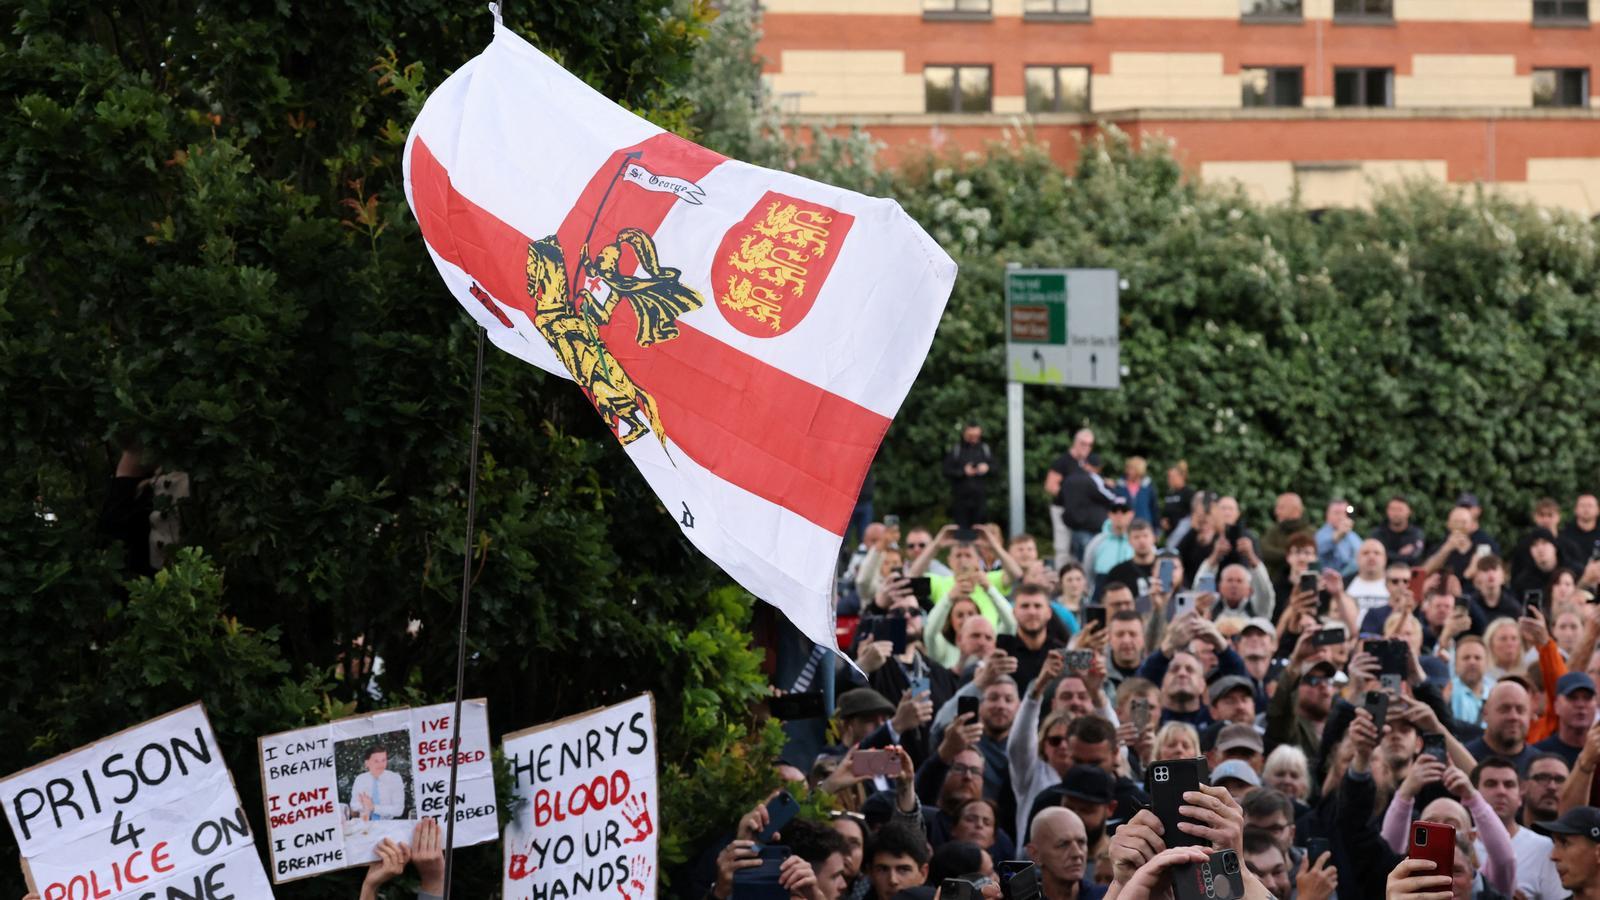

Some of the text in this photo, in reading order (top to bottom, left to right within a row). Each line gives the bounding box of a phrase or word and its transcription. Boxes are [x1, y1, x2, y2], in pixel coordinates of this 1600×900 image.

[648, 175, 688, 194] George
[421, 717, 450, 733] IVE
[265, 738, 329, 762] I CANT
[513, 712, 648, 789] HENRYS
[270, 755, 334, 780] BREATHE
[13, 727, 212, 840] PRISON
[421, 780, 446, 795] IVE
[269, 787, 329, 811] I CANT
[534, 769, 630, 827] BLOOD
[270, 801, 334, 828] BREATHE
[110, 810, 145, 848] 4
[275, 828, 336, 852] I CANT
[44, 808, 250, 900] POLICE ON
[278, 849, 344, 875] BREATHE
[532, 855, 630, 900] HANDS
